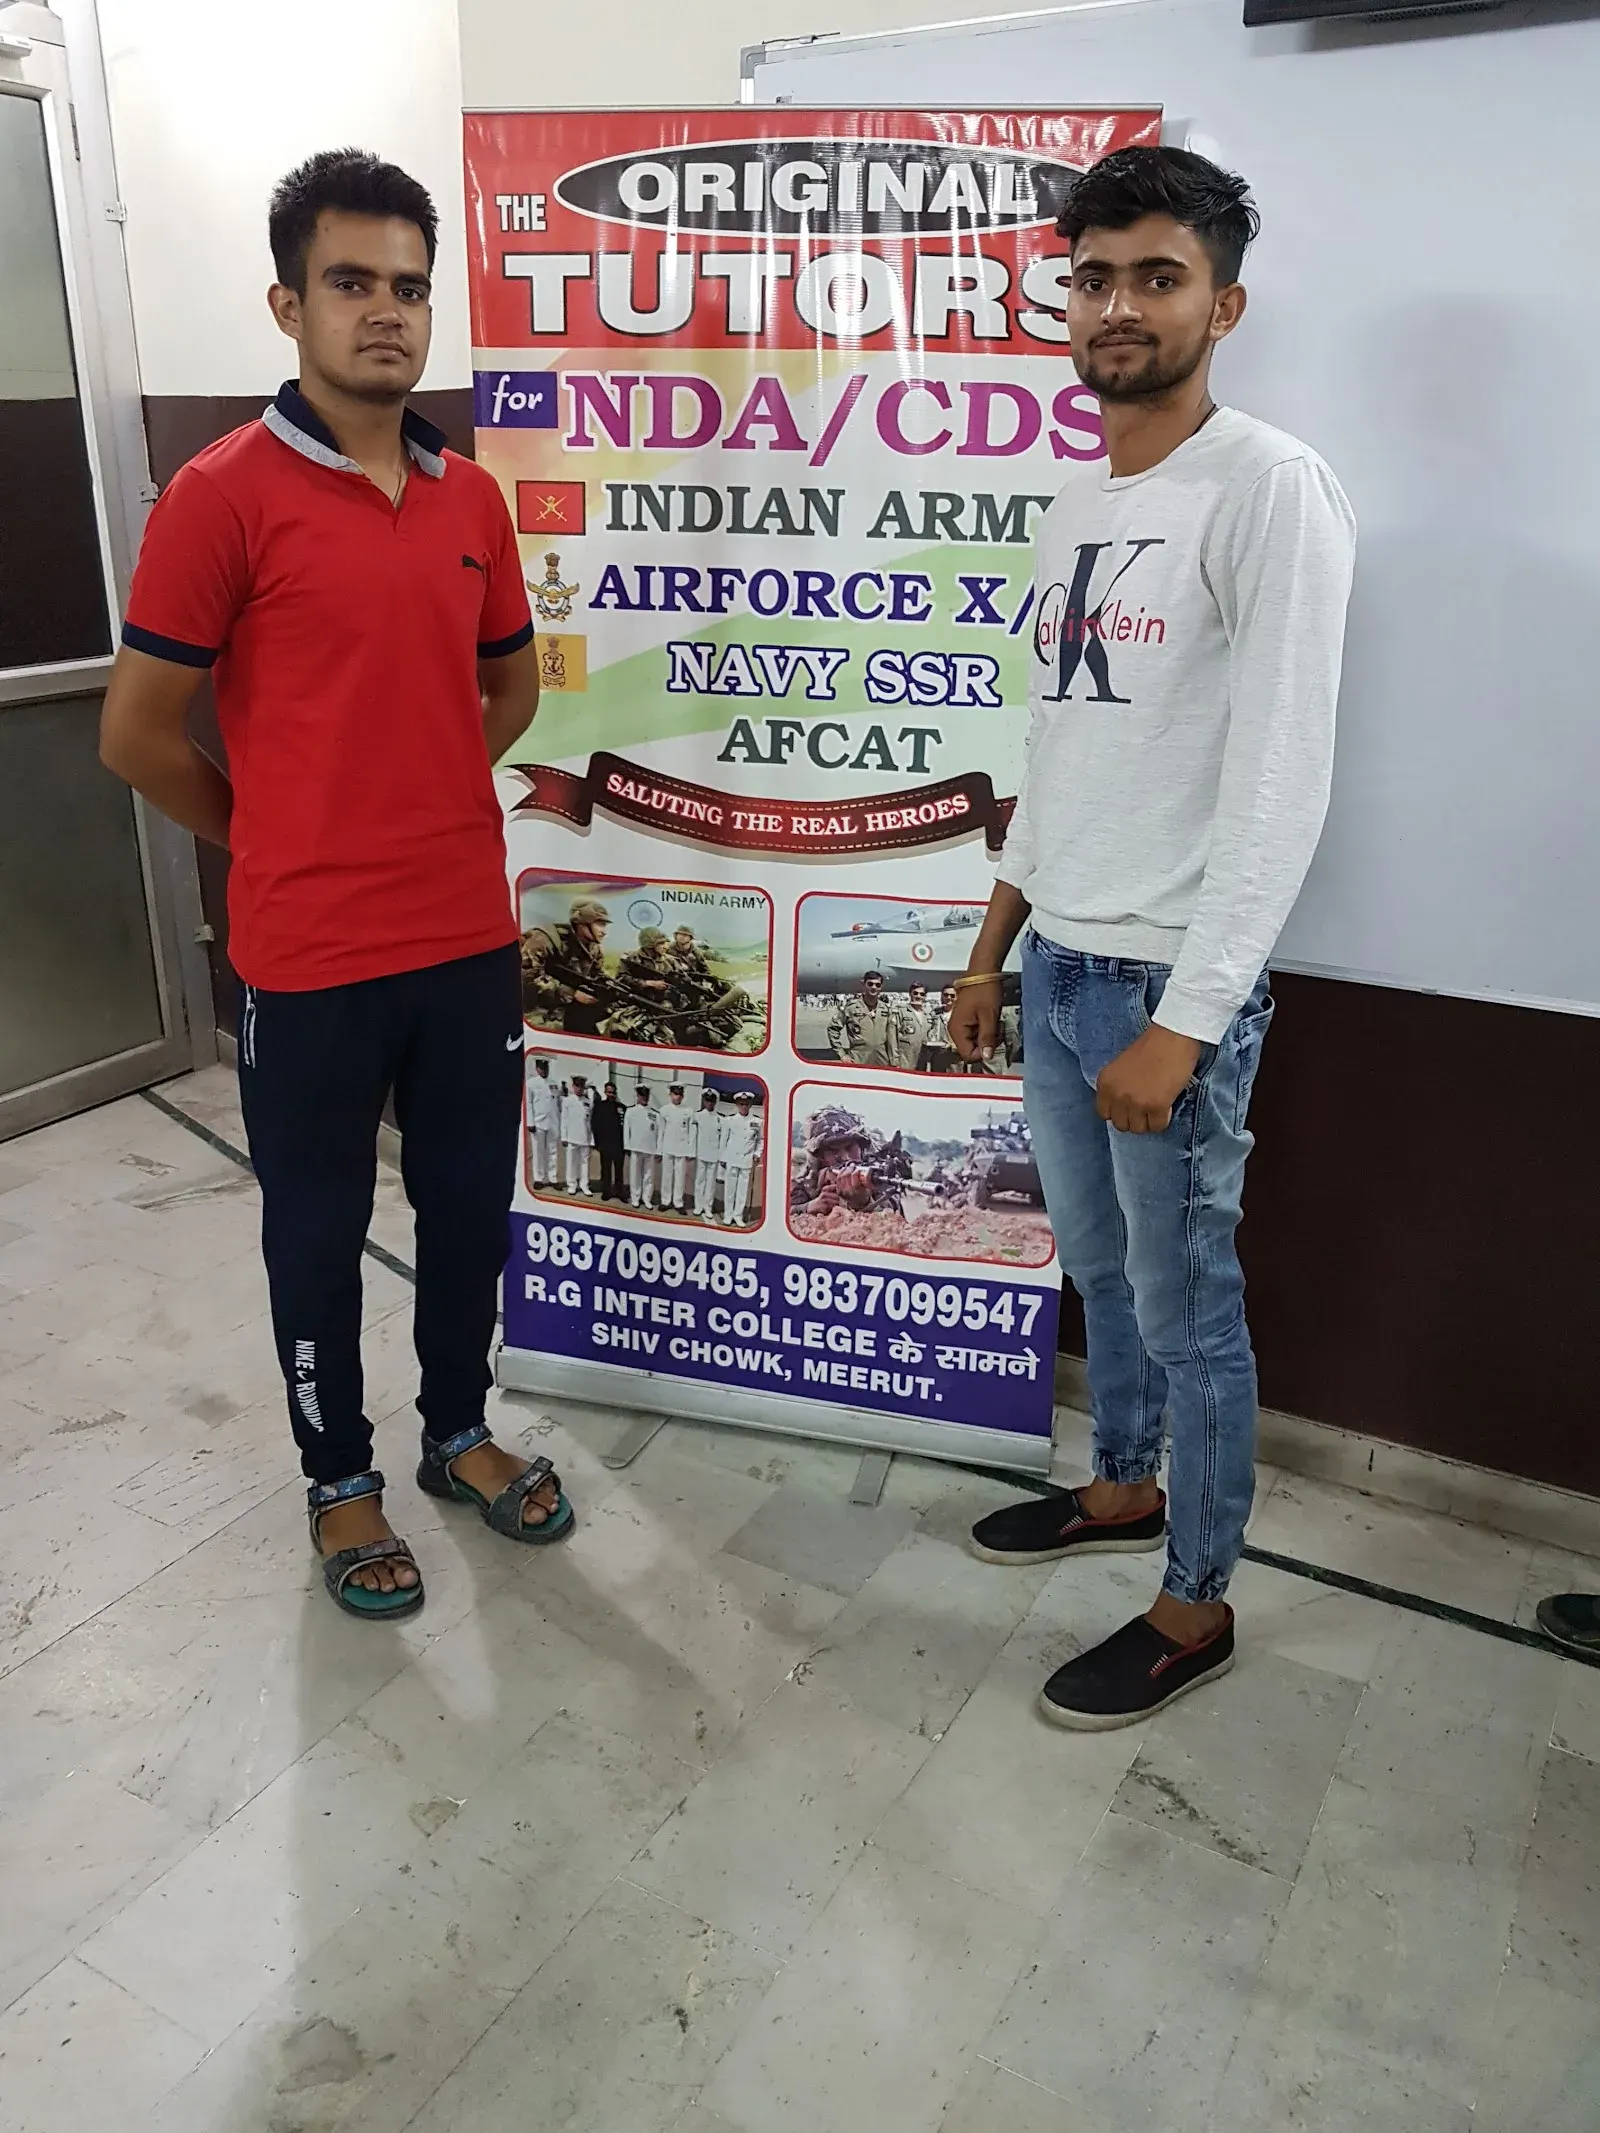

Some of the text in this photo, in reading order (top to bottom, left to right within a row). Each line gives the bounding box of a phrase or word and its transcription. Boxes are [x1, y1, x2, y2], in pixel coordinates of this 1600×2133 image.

[496, 194, 548, 232] THE
[617, 161, 1040, 216] ORIGINAL
[502, 251, 1071, 345] TUTORS
[491, 374, 543, 424] for
[564, 371, 1109, 467] NDA/CDS
[605, 483, 1056, 543] INDIAN ARM
[588, 564, 934, 620] AIRFORCE
[669, 642, 1003, 708] NAVY SSR
[716, 719, 942, 774] AFCAT
[606, 773, 972, 836] SALUTING THE REAL HEROES
[661, 890, 766, 910] INDIAN ARMY
[525, 1222, 1043, 1337] 9837099485, 9837099547
[295, 1339, 316, 1370] NIKE
[525, 1273, 1040, 1381] R.G INTER COLLEGE के सामने
[591, 1322, 944, 1402] SHIV CHOWK, MEERUT.
